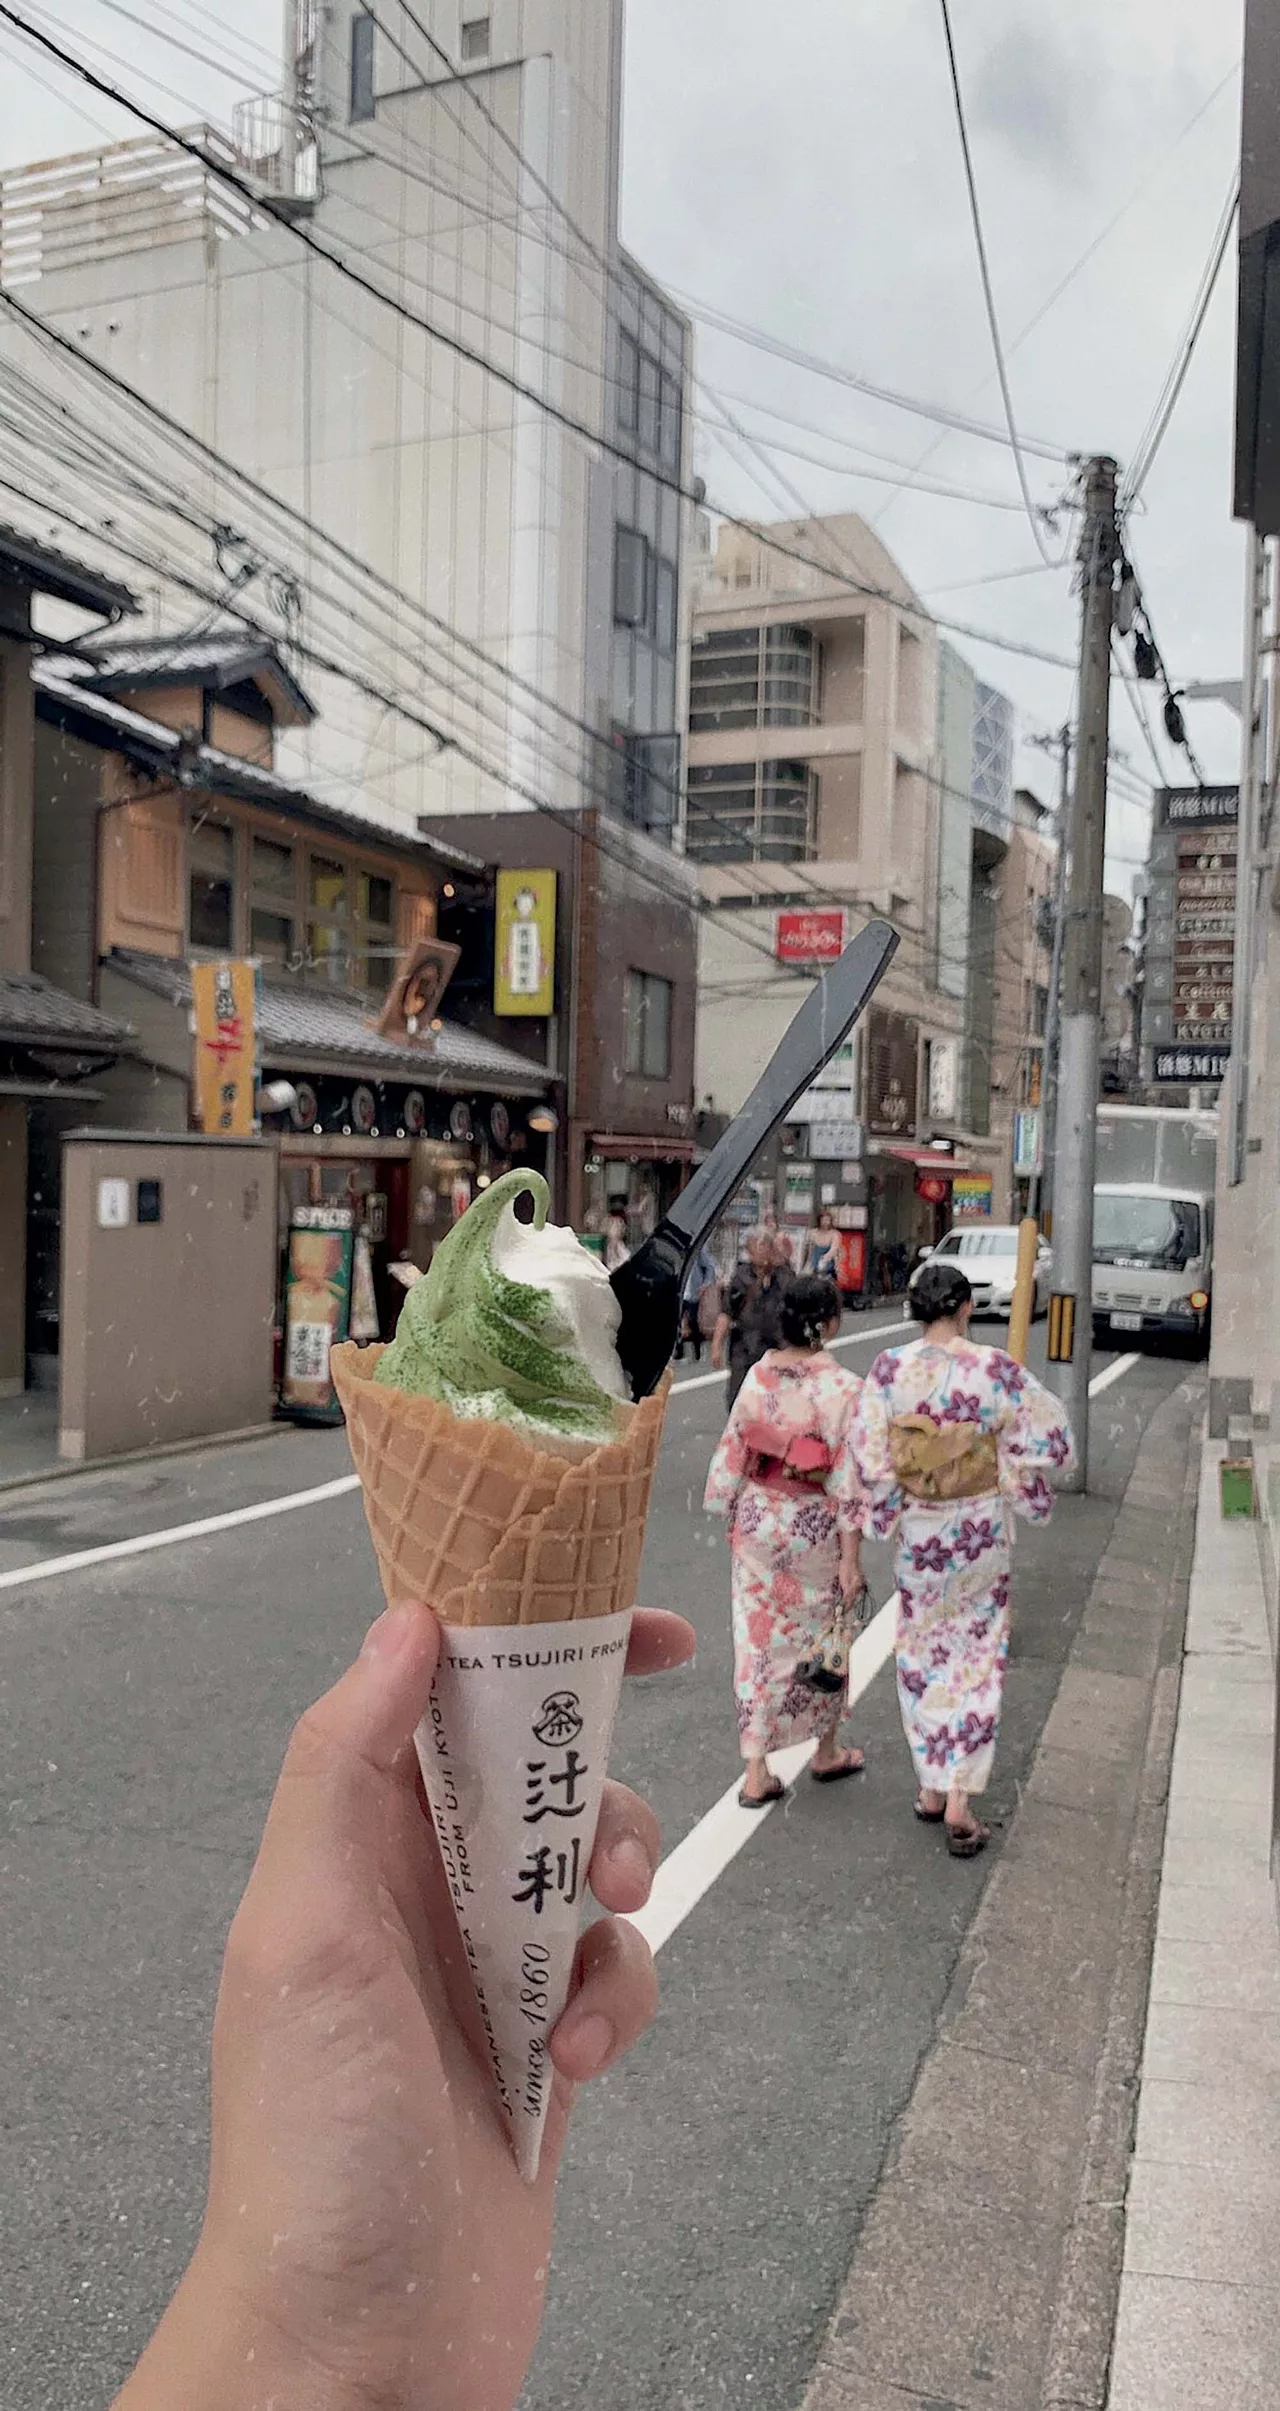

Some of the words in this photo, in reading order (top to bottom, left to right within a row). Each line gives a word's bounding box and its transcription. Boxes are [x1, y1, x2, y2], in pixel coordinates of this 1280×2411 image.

[448, 1655, 485, 1670] TEA
[491, 1646, 584, 1670] TSUJIRI
[442, 1769, 459, 1812] UJI
[433, 1804, 465, 1914] TSUJIRI
[452, 1823, 475, 1894] FROM
[511, 1750, 589, 1915] 辻利
[462, 1928, 479, 1971] TEA
[519, 1942, 551, 2026] 1860
[515, 2036, 547, 2119] since
